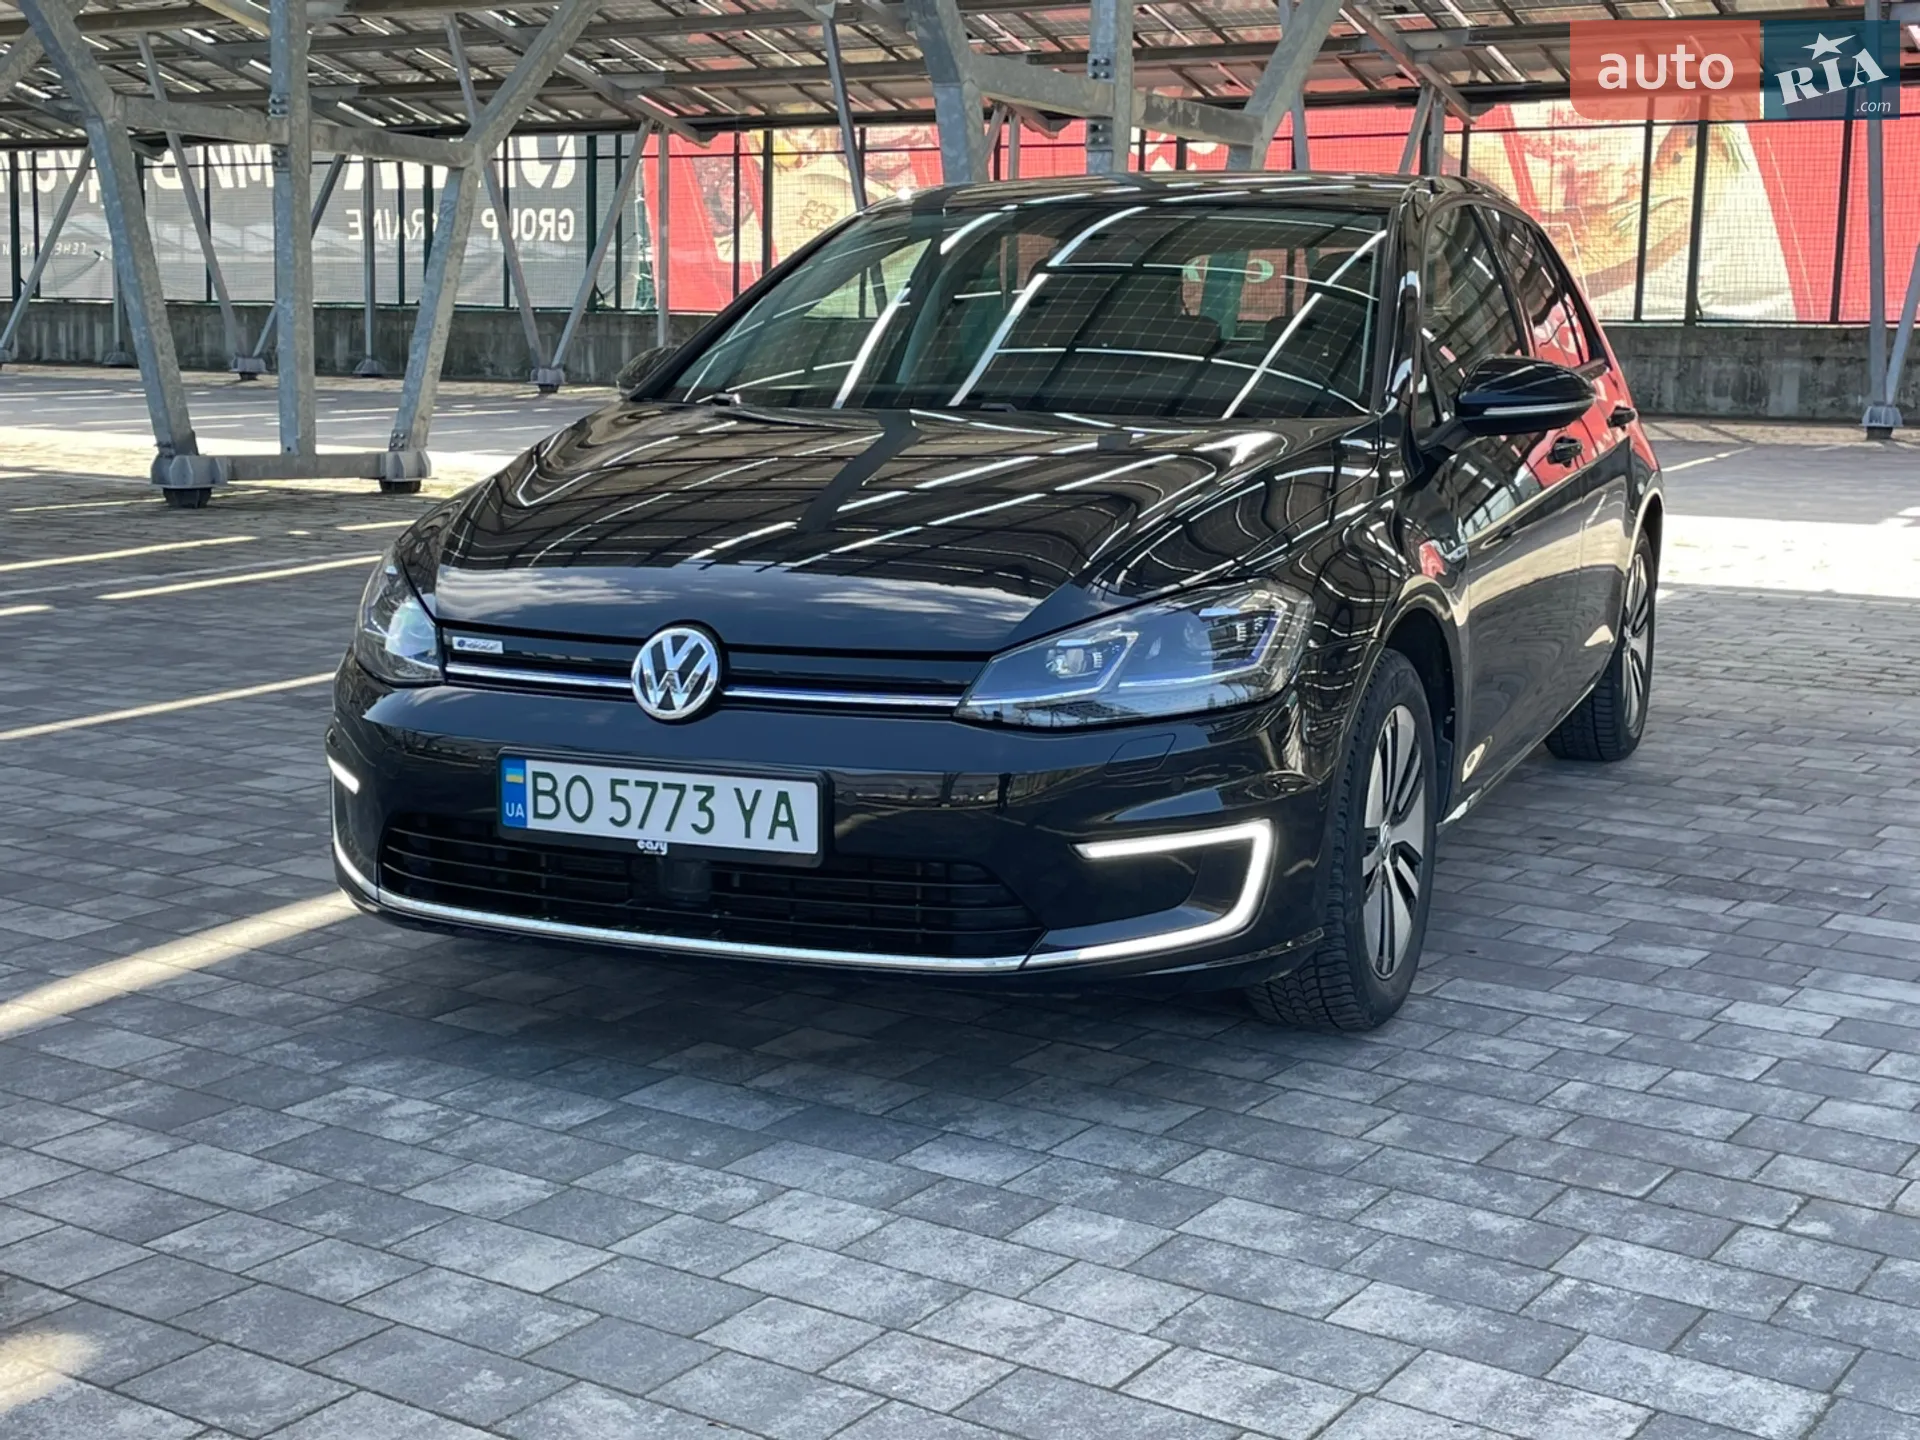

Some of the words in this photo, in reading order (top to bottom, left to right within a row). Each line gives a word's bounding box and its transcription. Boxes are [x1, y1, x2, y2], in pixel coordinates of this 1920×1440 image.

[505, 801, 525, 818] UA
[531, 770, 592, 823] BO
[608, 778, 715, 835] 5773
[733, 787, 799, 842] YA
[637, 839, 668, 856] easy
